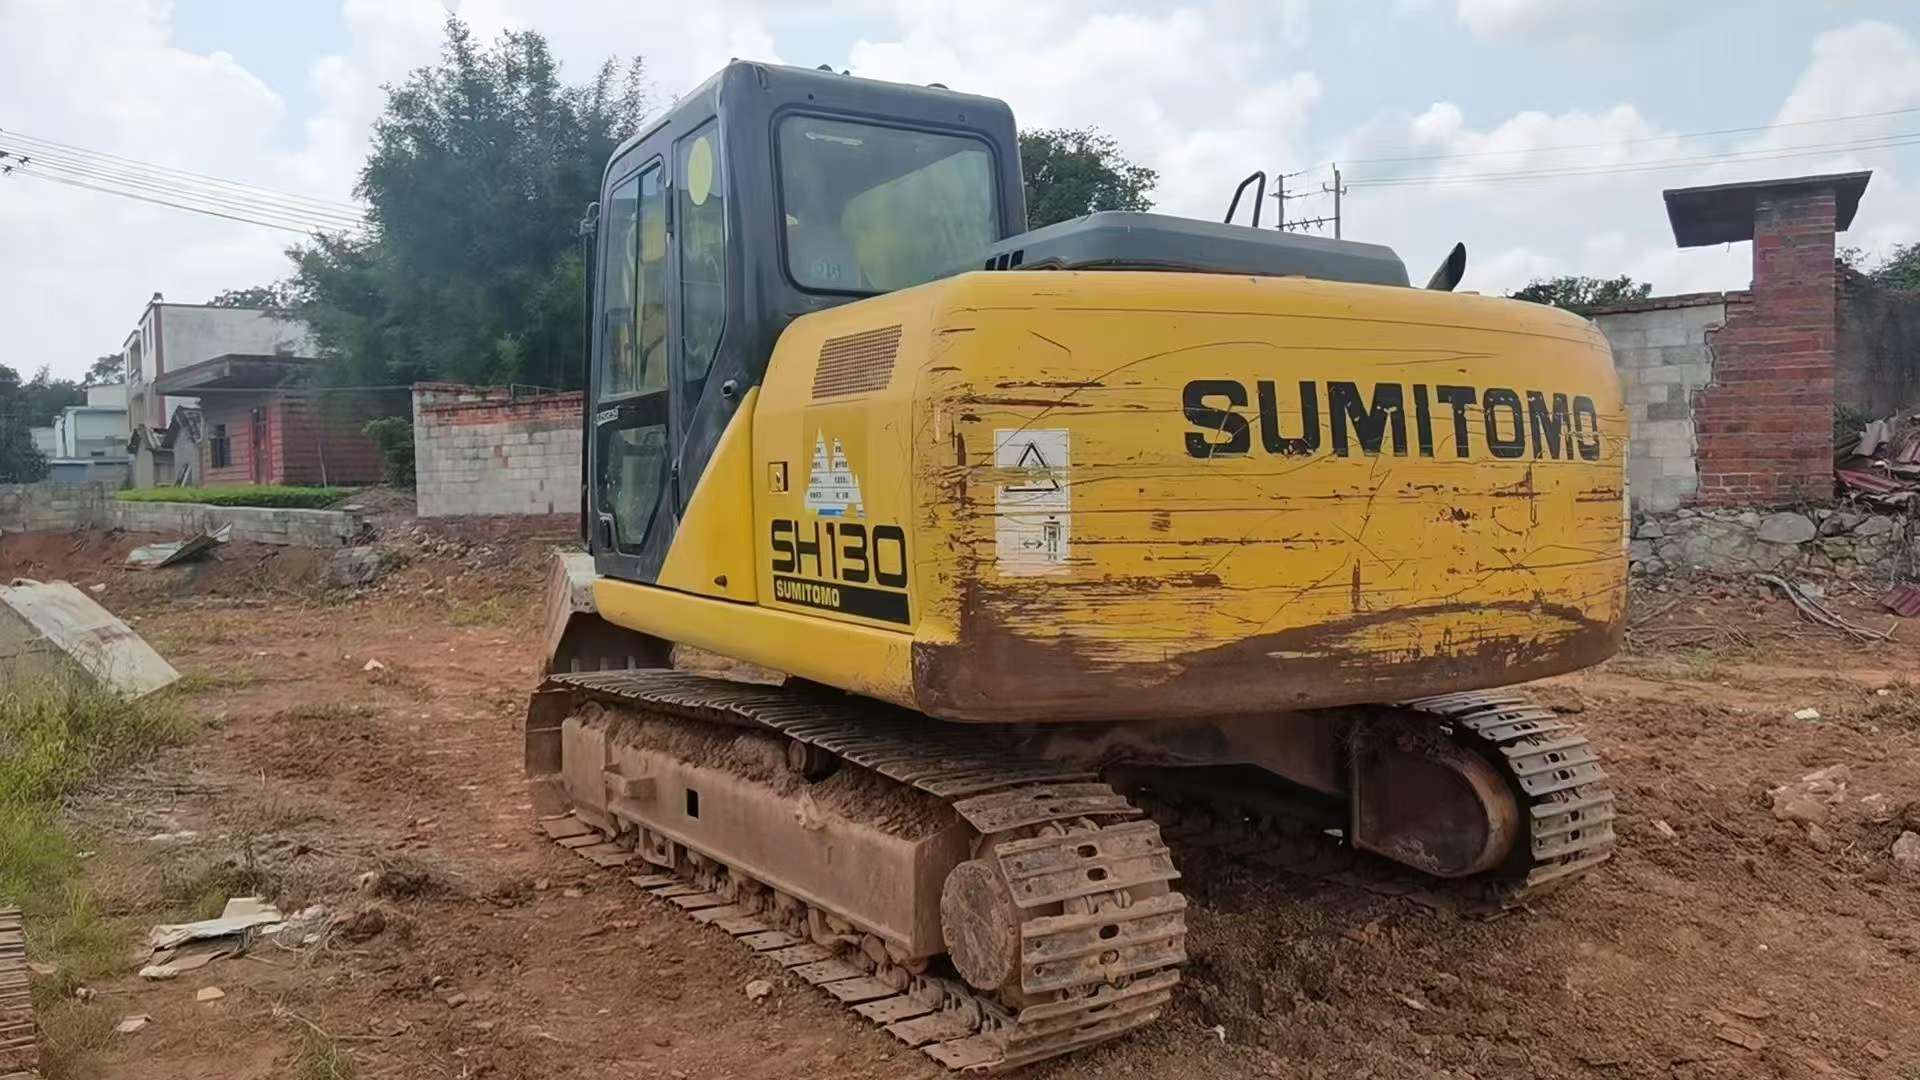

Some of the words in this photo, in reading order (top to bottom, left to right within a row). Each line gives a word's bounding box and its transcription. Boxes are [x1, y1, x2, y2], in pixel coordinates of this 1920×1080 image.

[1182, 379, 1601, 461] SUMITOMO
[771, 519, 908, 588] SH130
[776, 579, 840, 608] SUMITOMO
